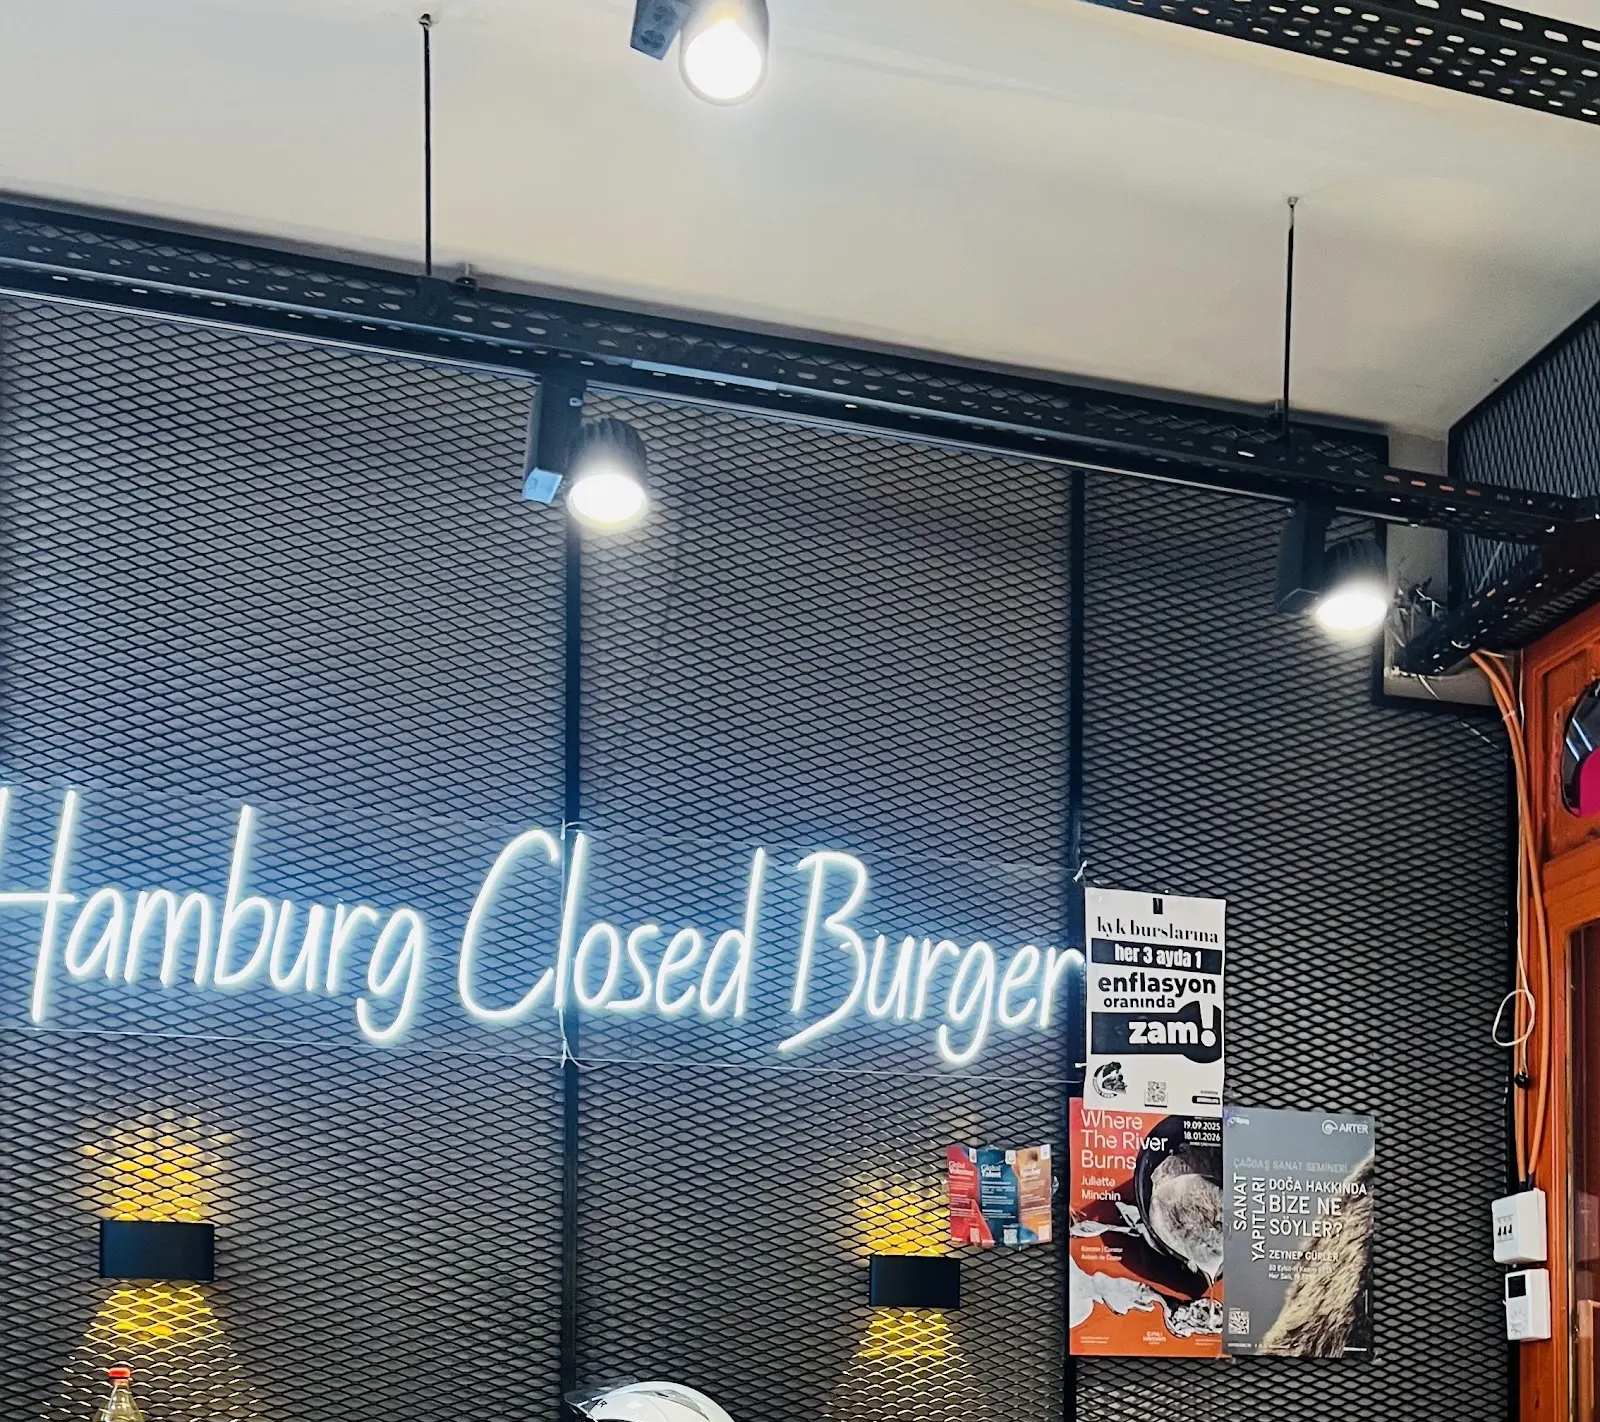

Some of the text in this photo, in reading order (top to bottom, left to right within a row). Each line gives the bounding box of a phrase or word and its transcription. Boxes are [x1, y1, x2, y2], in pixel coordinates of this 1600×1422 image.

[0, 787, 1085, 1063] Hamburg Closed Burger
[1098, 916, 1126, 937] kyk
[1114, 943, 1202, 969] her 3 ayda 1
[1098, 972, 1216, 998] enflasyon
[1104, 995, 1175, 1008] oranında
[1128, 1001, 1217, 1047] zam!
[1081, 1109, 1143, 1130] Where
[1183, 1120, 1221, 1131] 19.09.2025
[1339, 1121, 1369, 1134] ARTER
[1081, 1129, 1169, 1151] The River
[1183, 1131, 1221, 1142] 18.01.2026
[1081, 1150, 1136, 1170] Burns
[1272, 1160, 1303, 1171] SANAT
[1081, 1189, 1121, 1201] Minchin
[1269, 1176, 1367, 1196] DOĞA HAKKINDA
[1234, 1172, 1247, 1231] SANAT
[1269, 1192, 1342, 1216] BİZE NE
[1252, 1177, 1265, 1262] YAPITLARI
[1269, 1216, 1343, 1238] SÖYLER?
[1268, 1249, 1339, 1263] ZEYNEP GÜRLER
